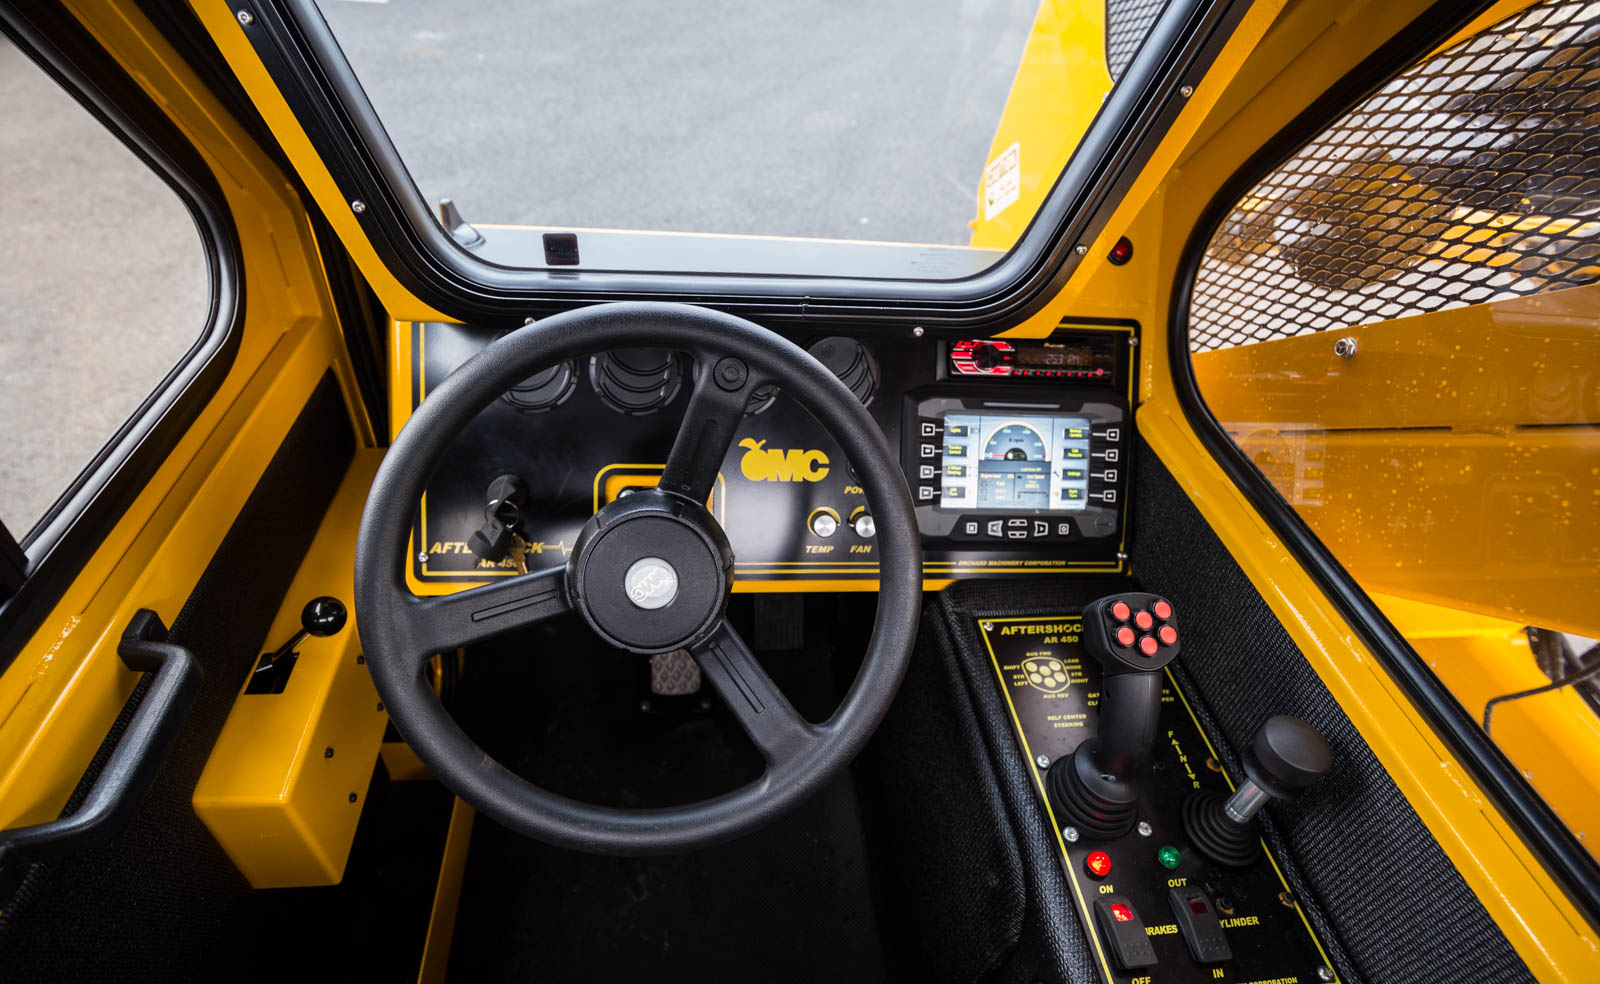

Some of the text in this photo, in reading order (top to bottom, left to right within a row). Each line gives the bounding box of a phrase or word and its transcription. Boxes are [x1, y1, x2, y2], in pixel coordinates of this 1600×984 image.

[738, 438, 830, 482] OMC
[805, 545, 834, 554] TEMP
[850, 545, 872, 553] FAN
[1001, 624, 1084, 636] AFTERSHOC
[1044, 636, 1058, 644] AR
[1180, 755, 1187, 763] N
[1193, 781, 1200, 789] R
[1168, 878, 1187, 887] OUT
[1099, 885, 1114, 894] ON
[1219, 916, 1260, 928] YLINDER
[1212, 968, 1225, 978] IN
